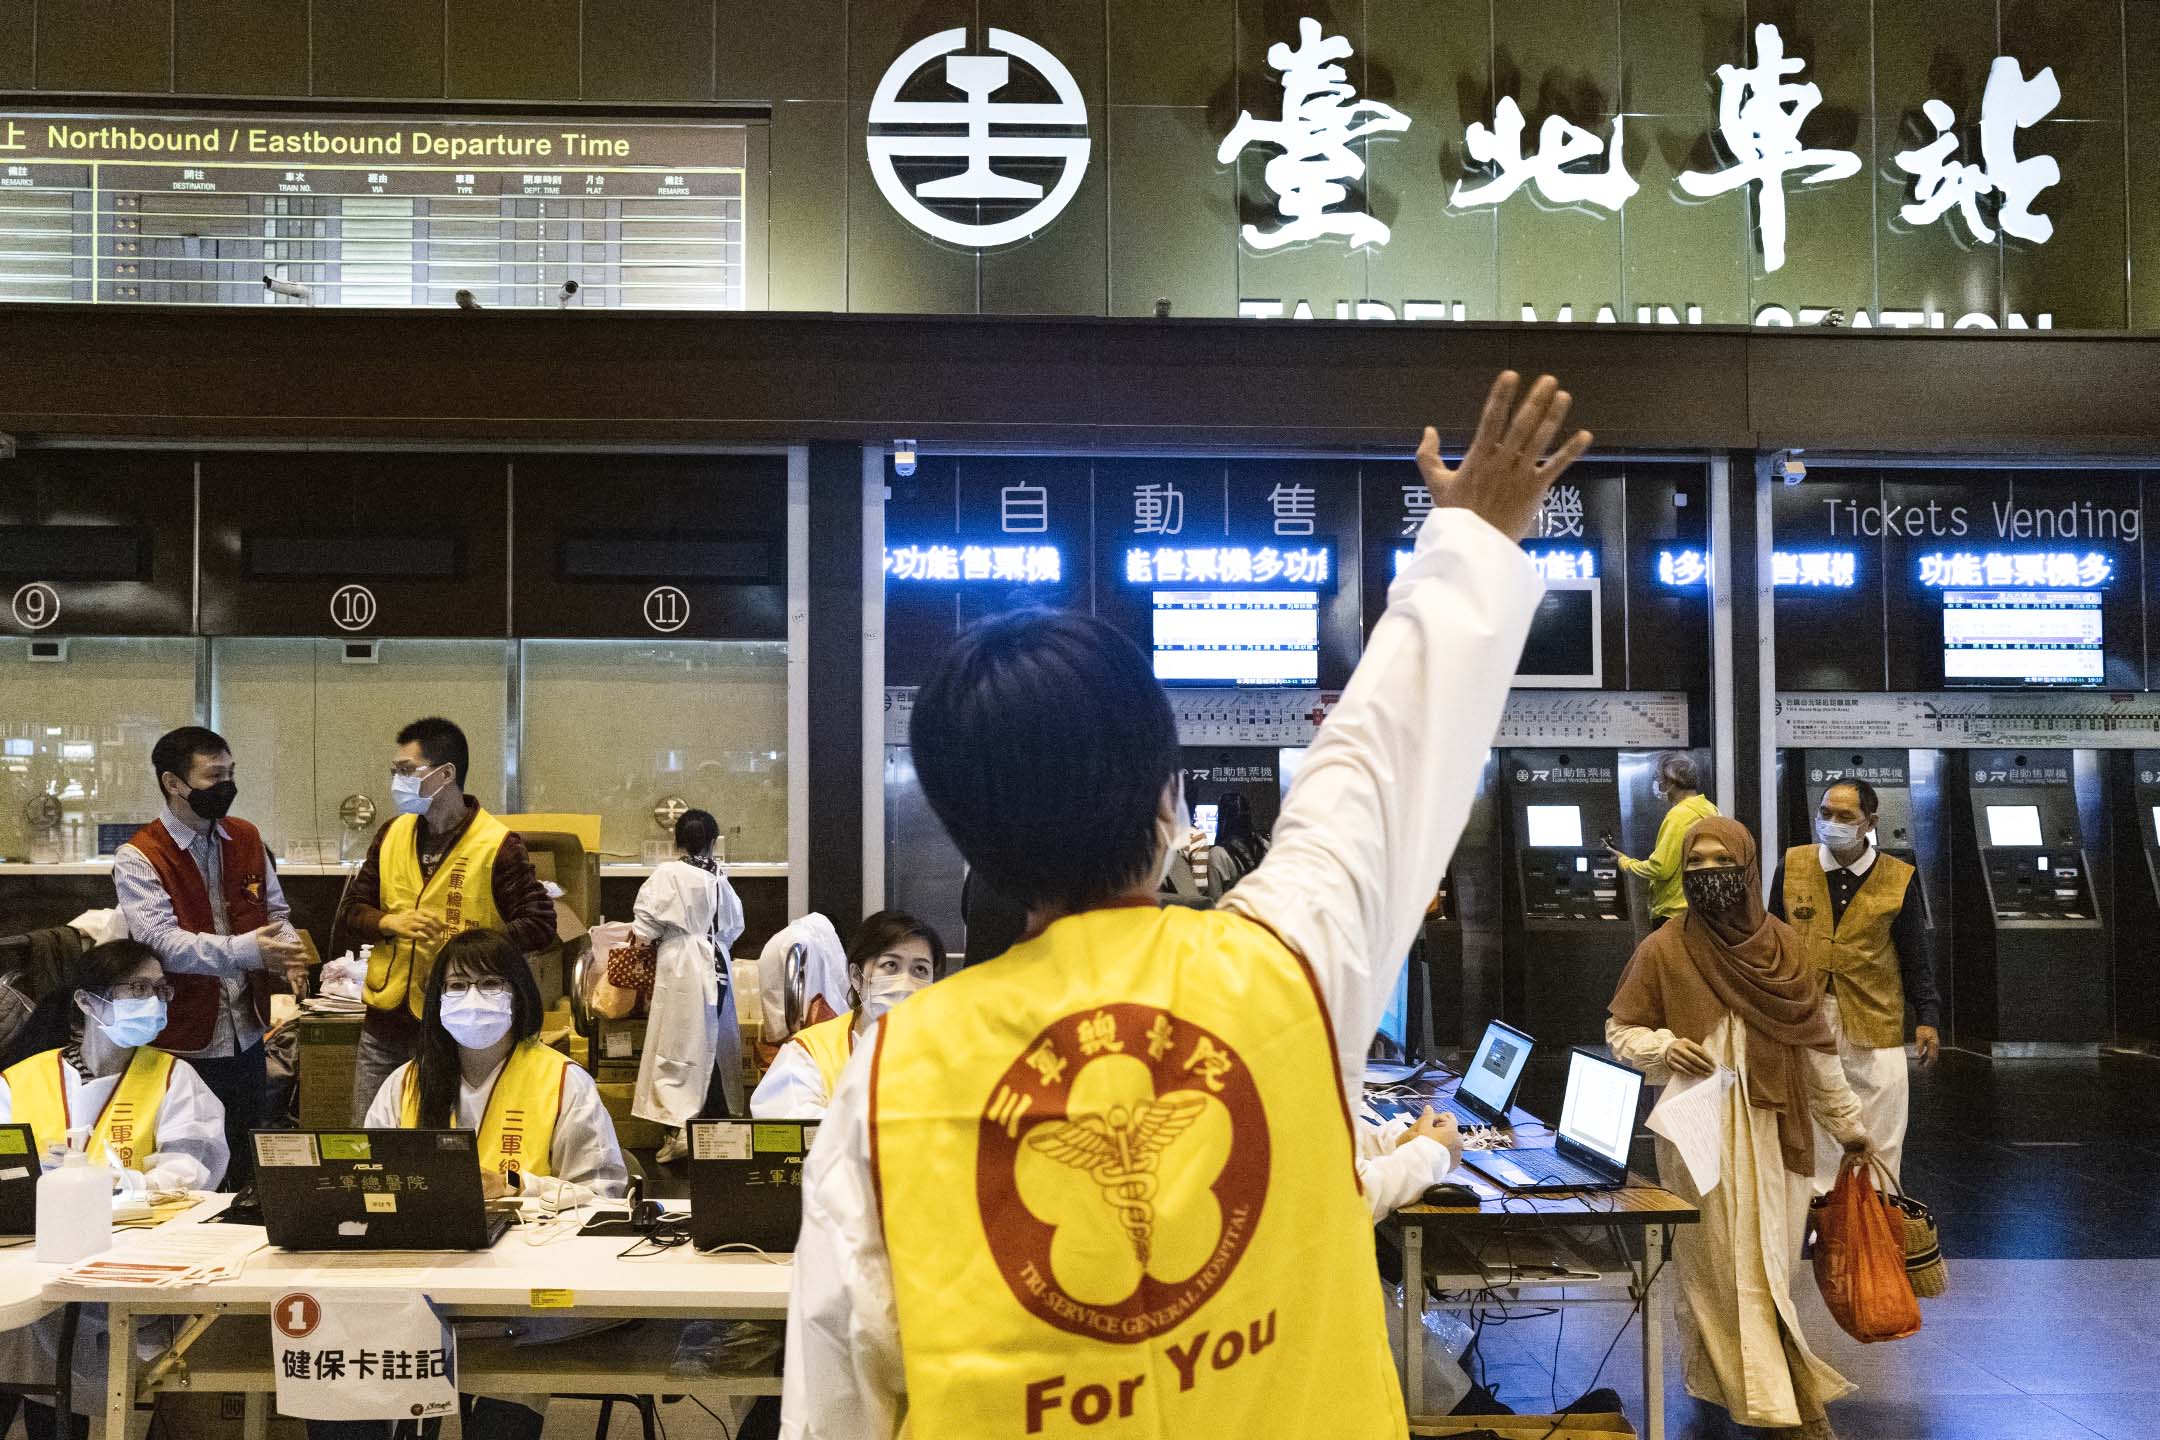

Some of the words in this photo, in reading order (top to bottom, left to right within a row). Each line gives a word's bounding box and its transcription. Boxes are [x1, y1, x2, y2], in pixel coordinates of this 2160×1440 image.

[49, 125, 219, 151] Northbound
[249, 129, 401, 154] Eastbound
[412, 133, 552, 159] Departure
[561, 134, 630, 156] Time
[1218, 17, 2060, 272] 臺北車站
[1, 178, 34, 186] REMARKS
[585, 175, 605, 185] 月台
[172, 182, 216, 191] DESTINATION
[279, 183, 299, 192] TRAIN
[371, 185, 384, 193] VIA
[457, 186, 473, 194] TYPE
[658, 188, 690, 196] REMARKS
[1823, 499, 1969, 538] Tickets
[1992, 499, 2140, 542] Vending
[884, 545, 1060, 582] 功能售票機
[1212, 766, 1273, 777] 自動售票機
[1552, 767, 1611, 778] 自動售票機
[315, 1174, 429, 1192] 三軍總醫院
[282, 1348, 448, 1381] 健保卡註記
[1025, 1374, 1146, 1435] For
[1165, 1309, 1277, 1393] You
